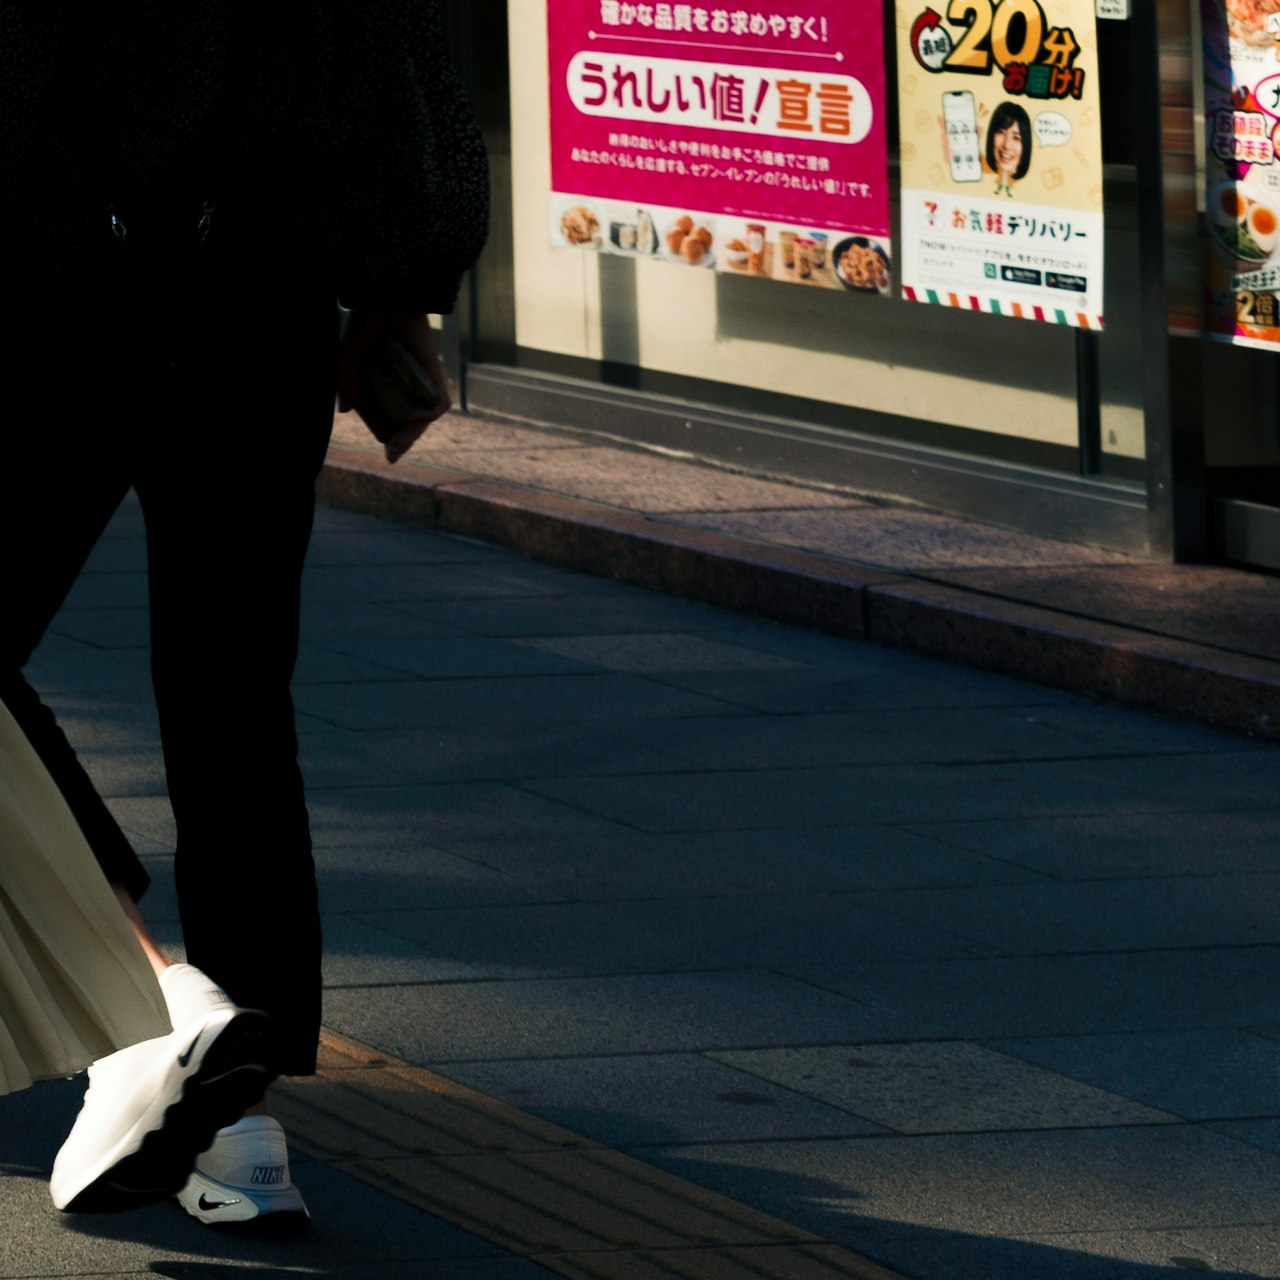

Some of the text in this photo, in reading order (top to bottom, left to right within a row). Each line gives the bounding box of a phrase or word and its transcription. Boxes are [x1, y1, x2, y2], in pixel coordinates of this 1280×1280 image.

[580, 60, 854, 136] うれしい値!宣言
[951, 208, 1087, 242] お気軽デリバリー
[250, 1165, 284, 1185] NIKE
